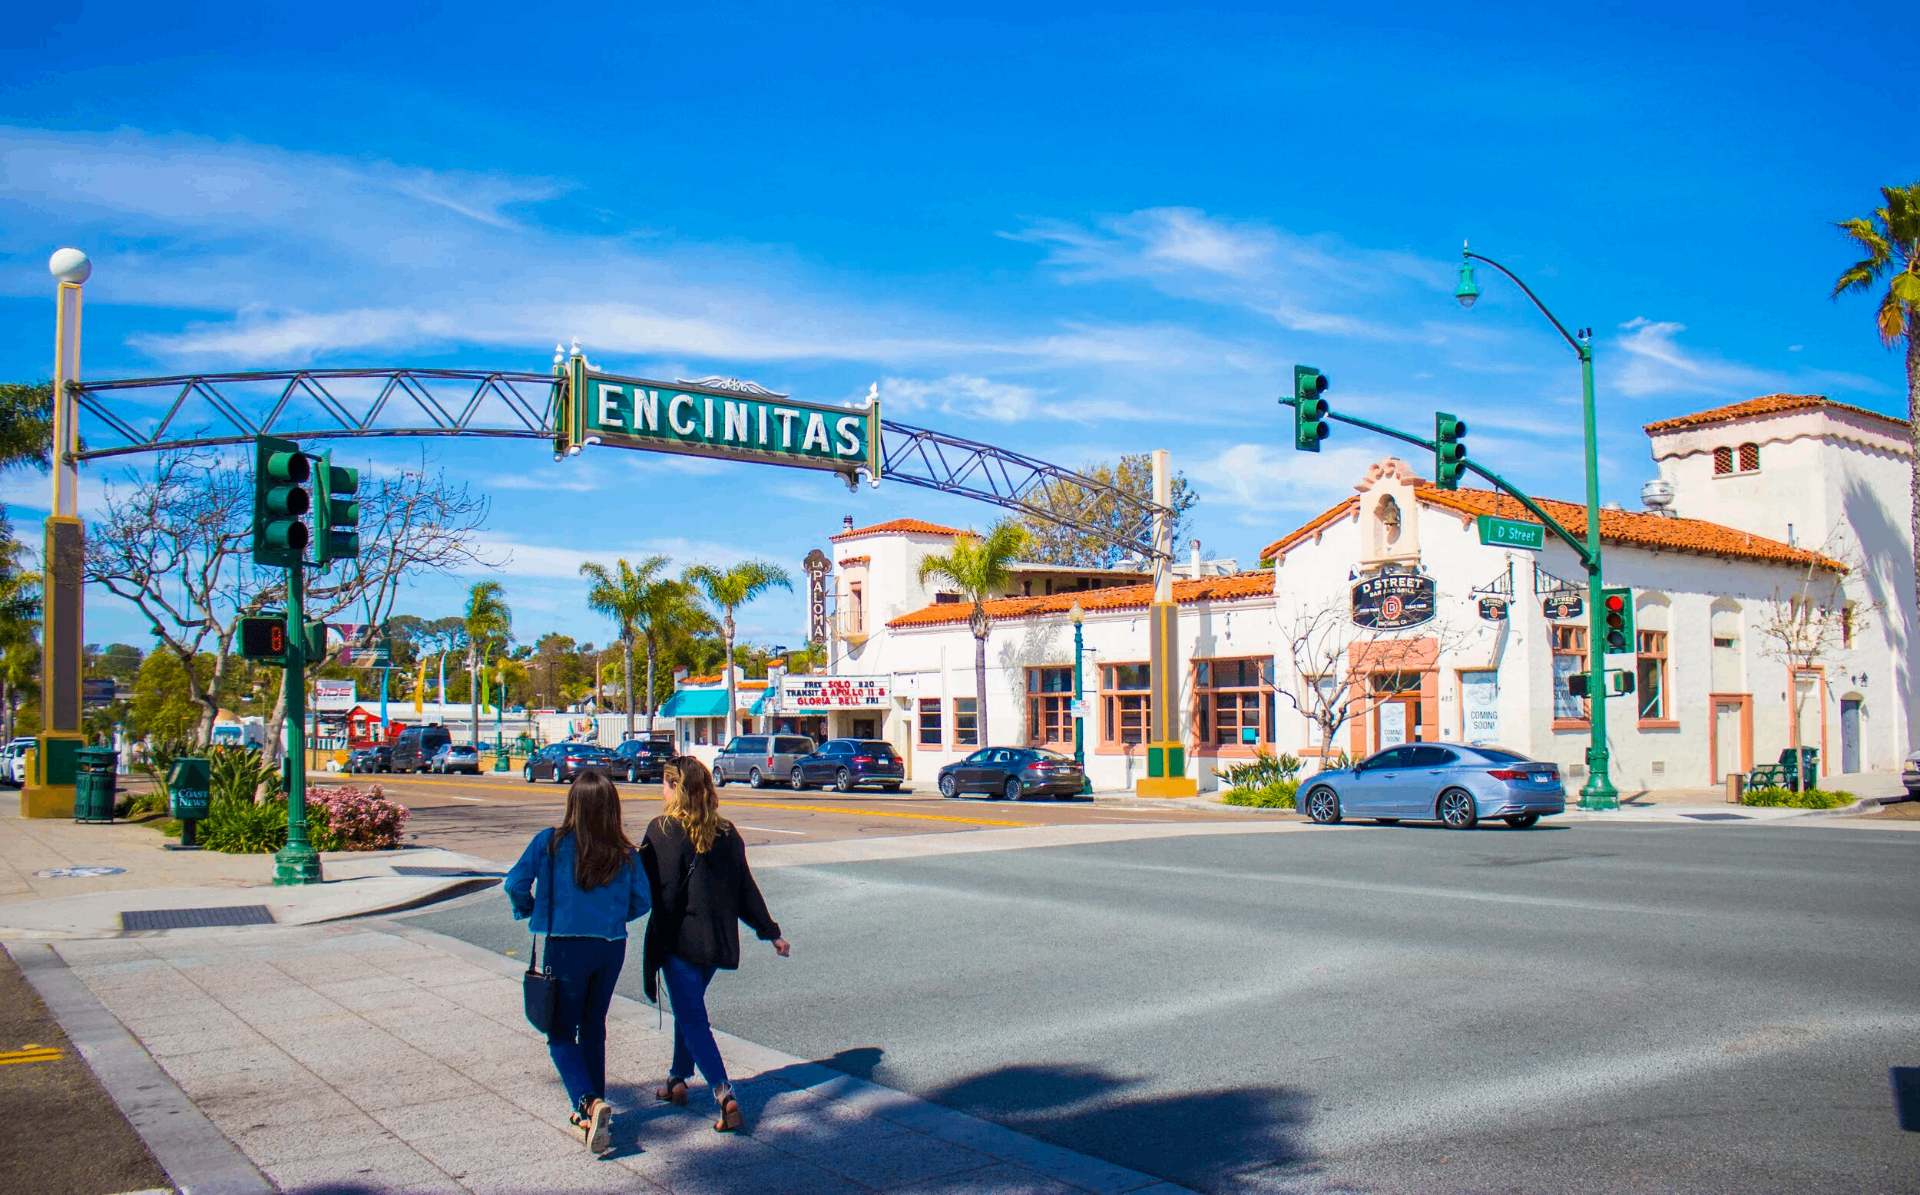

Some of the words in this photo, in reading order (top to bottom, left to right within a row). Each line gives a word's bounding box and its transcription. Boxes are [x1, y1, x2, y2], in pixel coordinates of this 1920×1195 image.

[598, 383, 861, 456] ENCINITAS
[1497, 525, 1504, 538] D
[1508, 526, 1536, 542] Street
[1362, 583, 1371, 594] D
[1374, 577, 1423, 590] STREET
[1369, 590, 1382, 598] BAR
[813, 570, 824, 637] PALOMA
[804, 681, 822, 689] FREE
[828, 680, 850, 689] SOLO
[786, 689, 819, 697] TRANSIT
[830, 689, 864, 697] APOLLO
[797, 697, 831, 705] GLORIA
[1470, 711, 1498, 720] COMING
[1473, 720, 1495, 730] SOON!
[178, 788, 208, 798] COAST
[178, 798, 207, 807] NEWS
